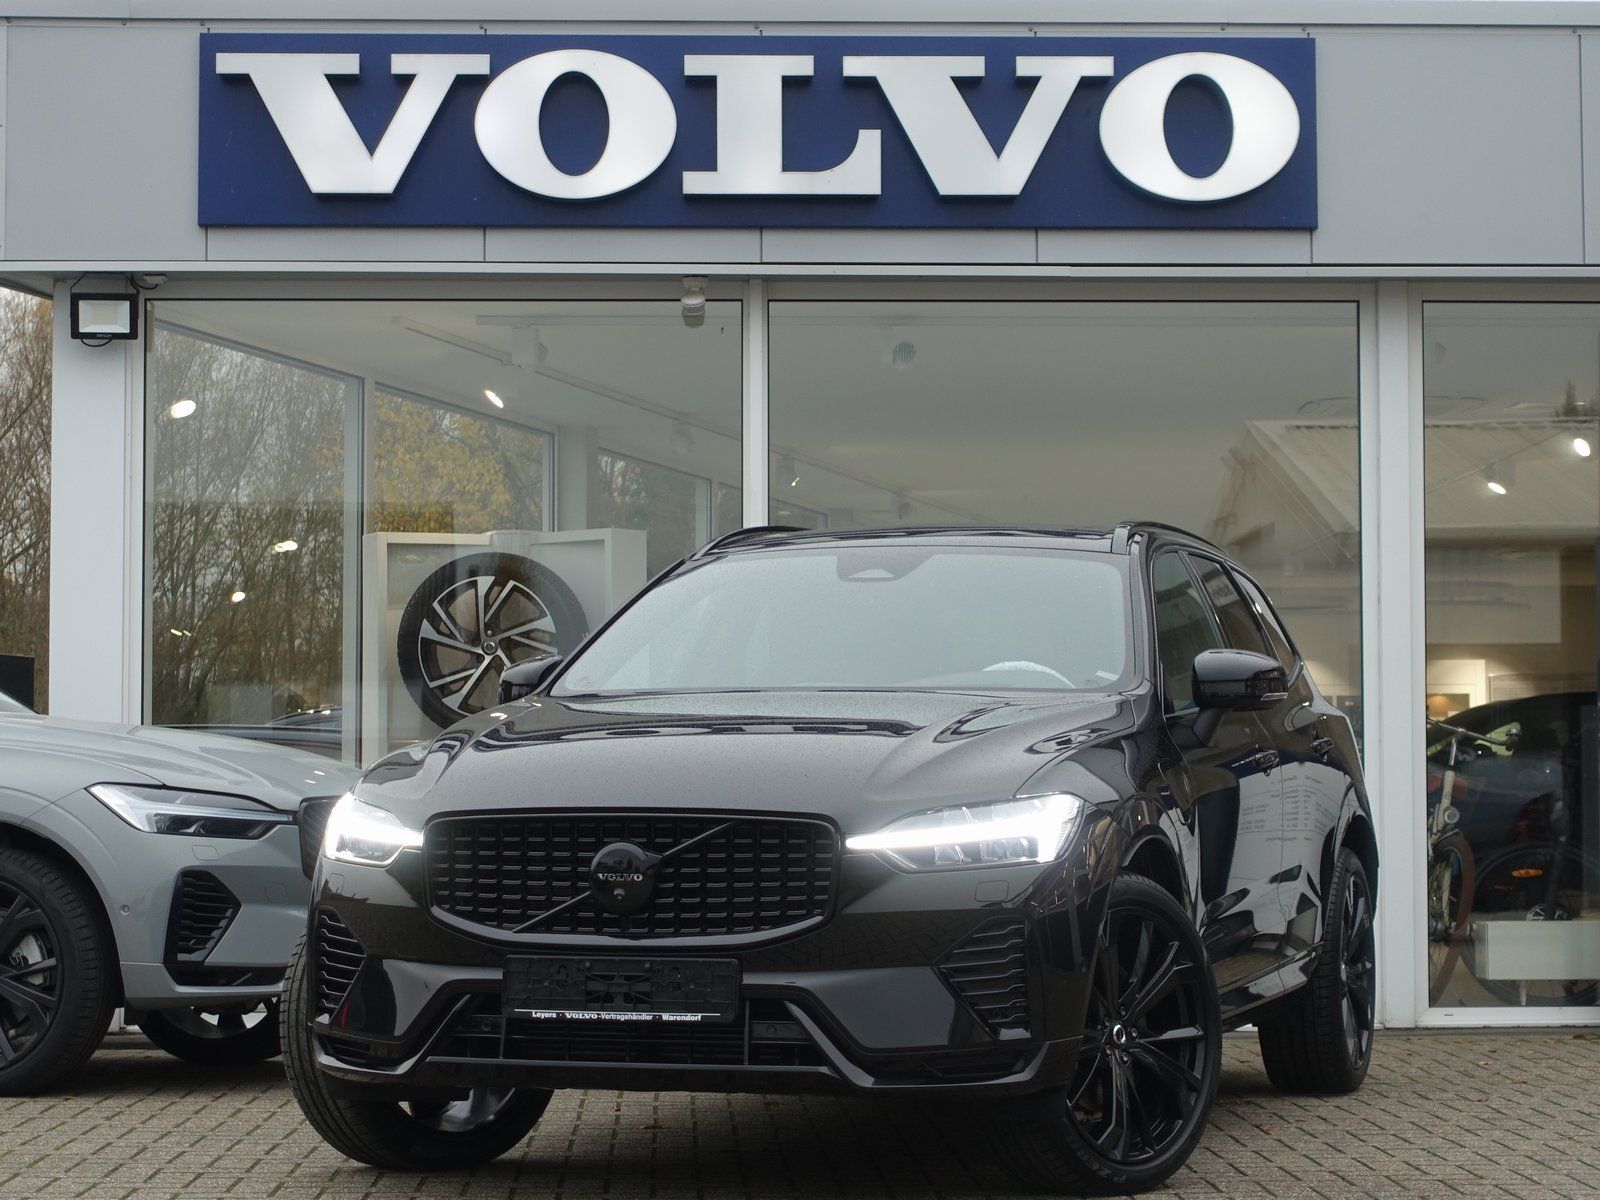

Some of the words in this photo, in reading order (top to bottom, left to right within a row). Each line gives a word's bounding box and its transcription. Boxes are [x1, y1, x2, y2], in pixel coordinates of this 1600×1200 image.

[215, 48, 1301, 201] VOLVO
[597, 873, 643, 881] VOLVO
[532, 1010, 557, 1019] Leyers
[661, 1013, 701, 1021] Warendorf
